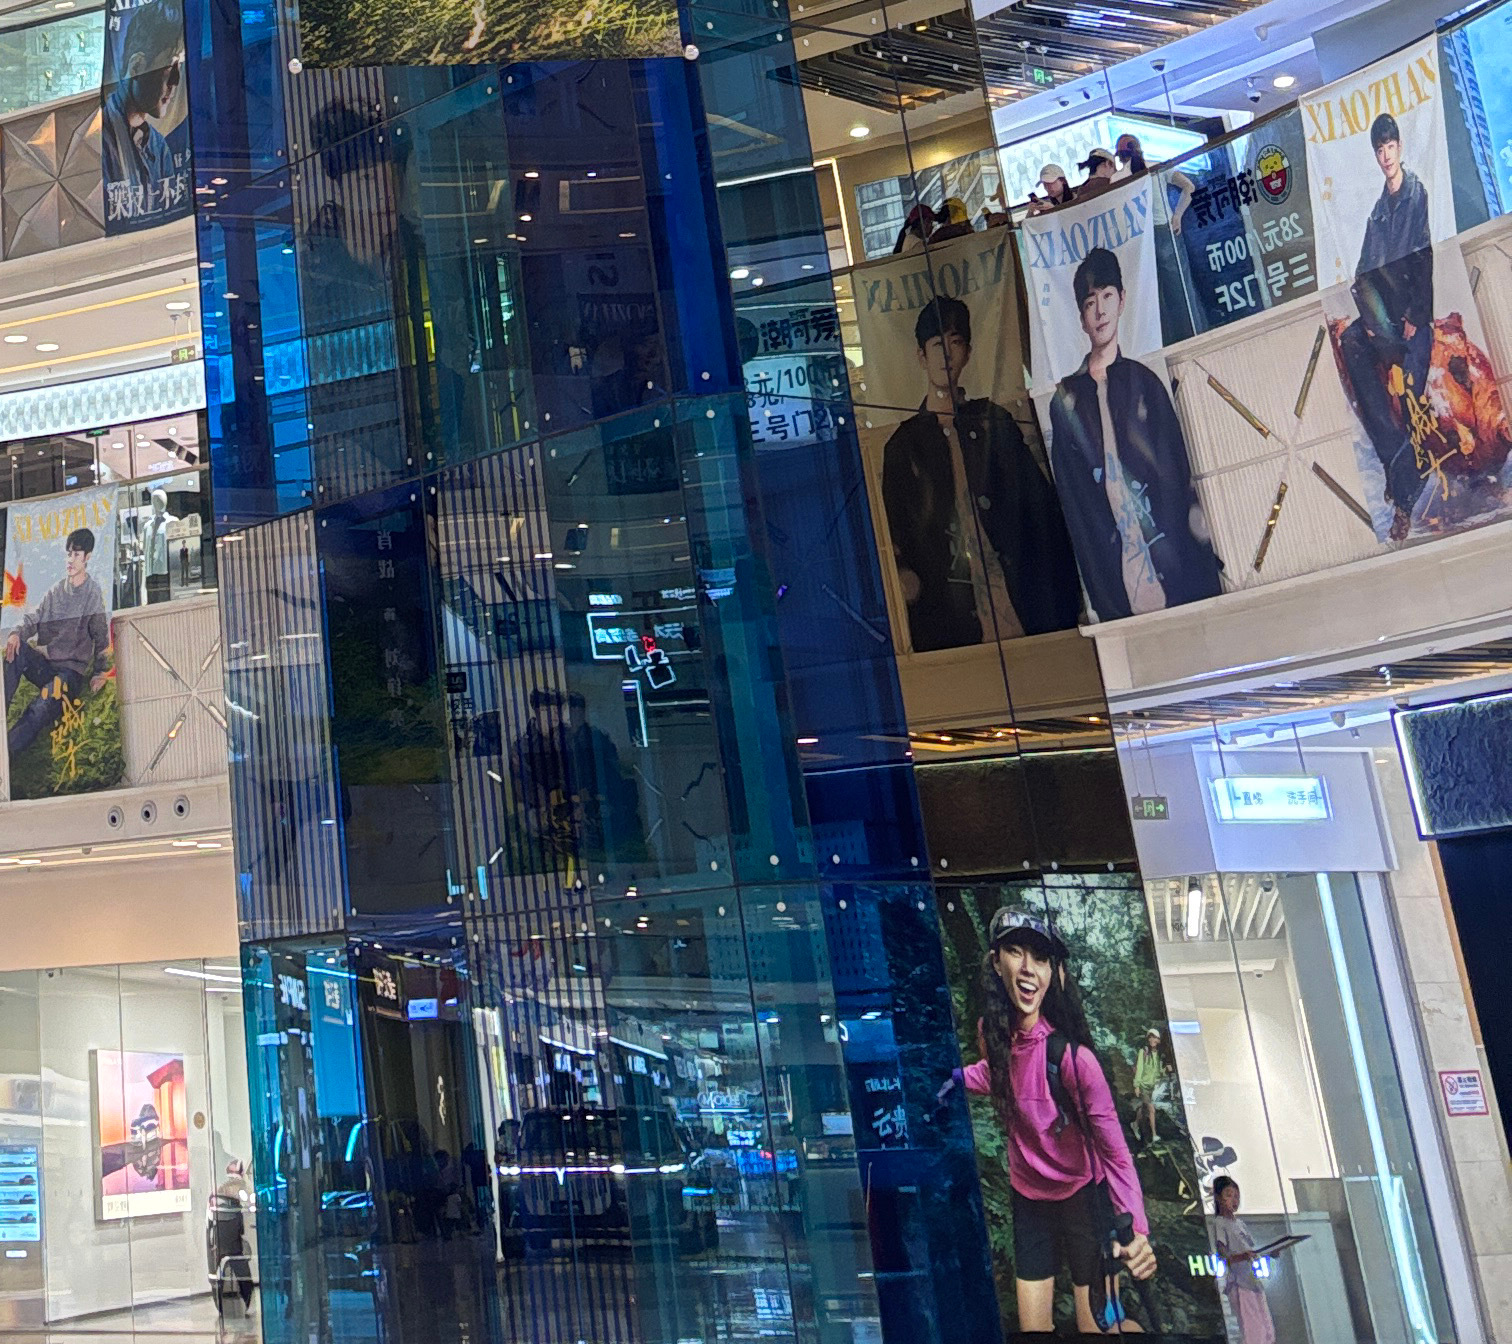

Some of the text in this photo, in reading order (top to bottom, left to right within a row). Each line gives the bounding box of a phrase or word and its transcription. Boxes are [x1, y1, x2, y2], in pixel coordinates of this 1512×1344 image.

[1307, 49, 1438, 145] XIAOZHAN
[108, 170, 187, 222] 谍报上不封
